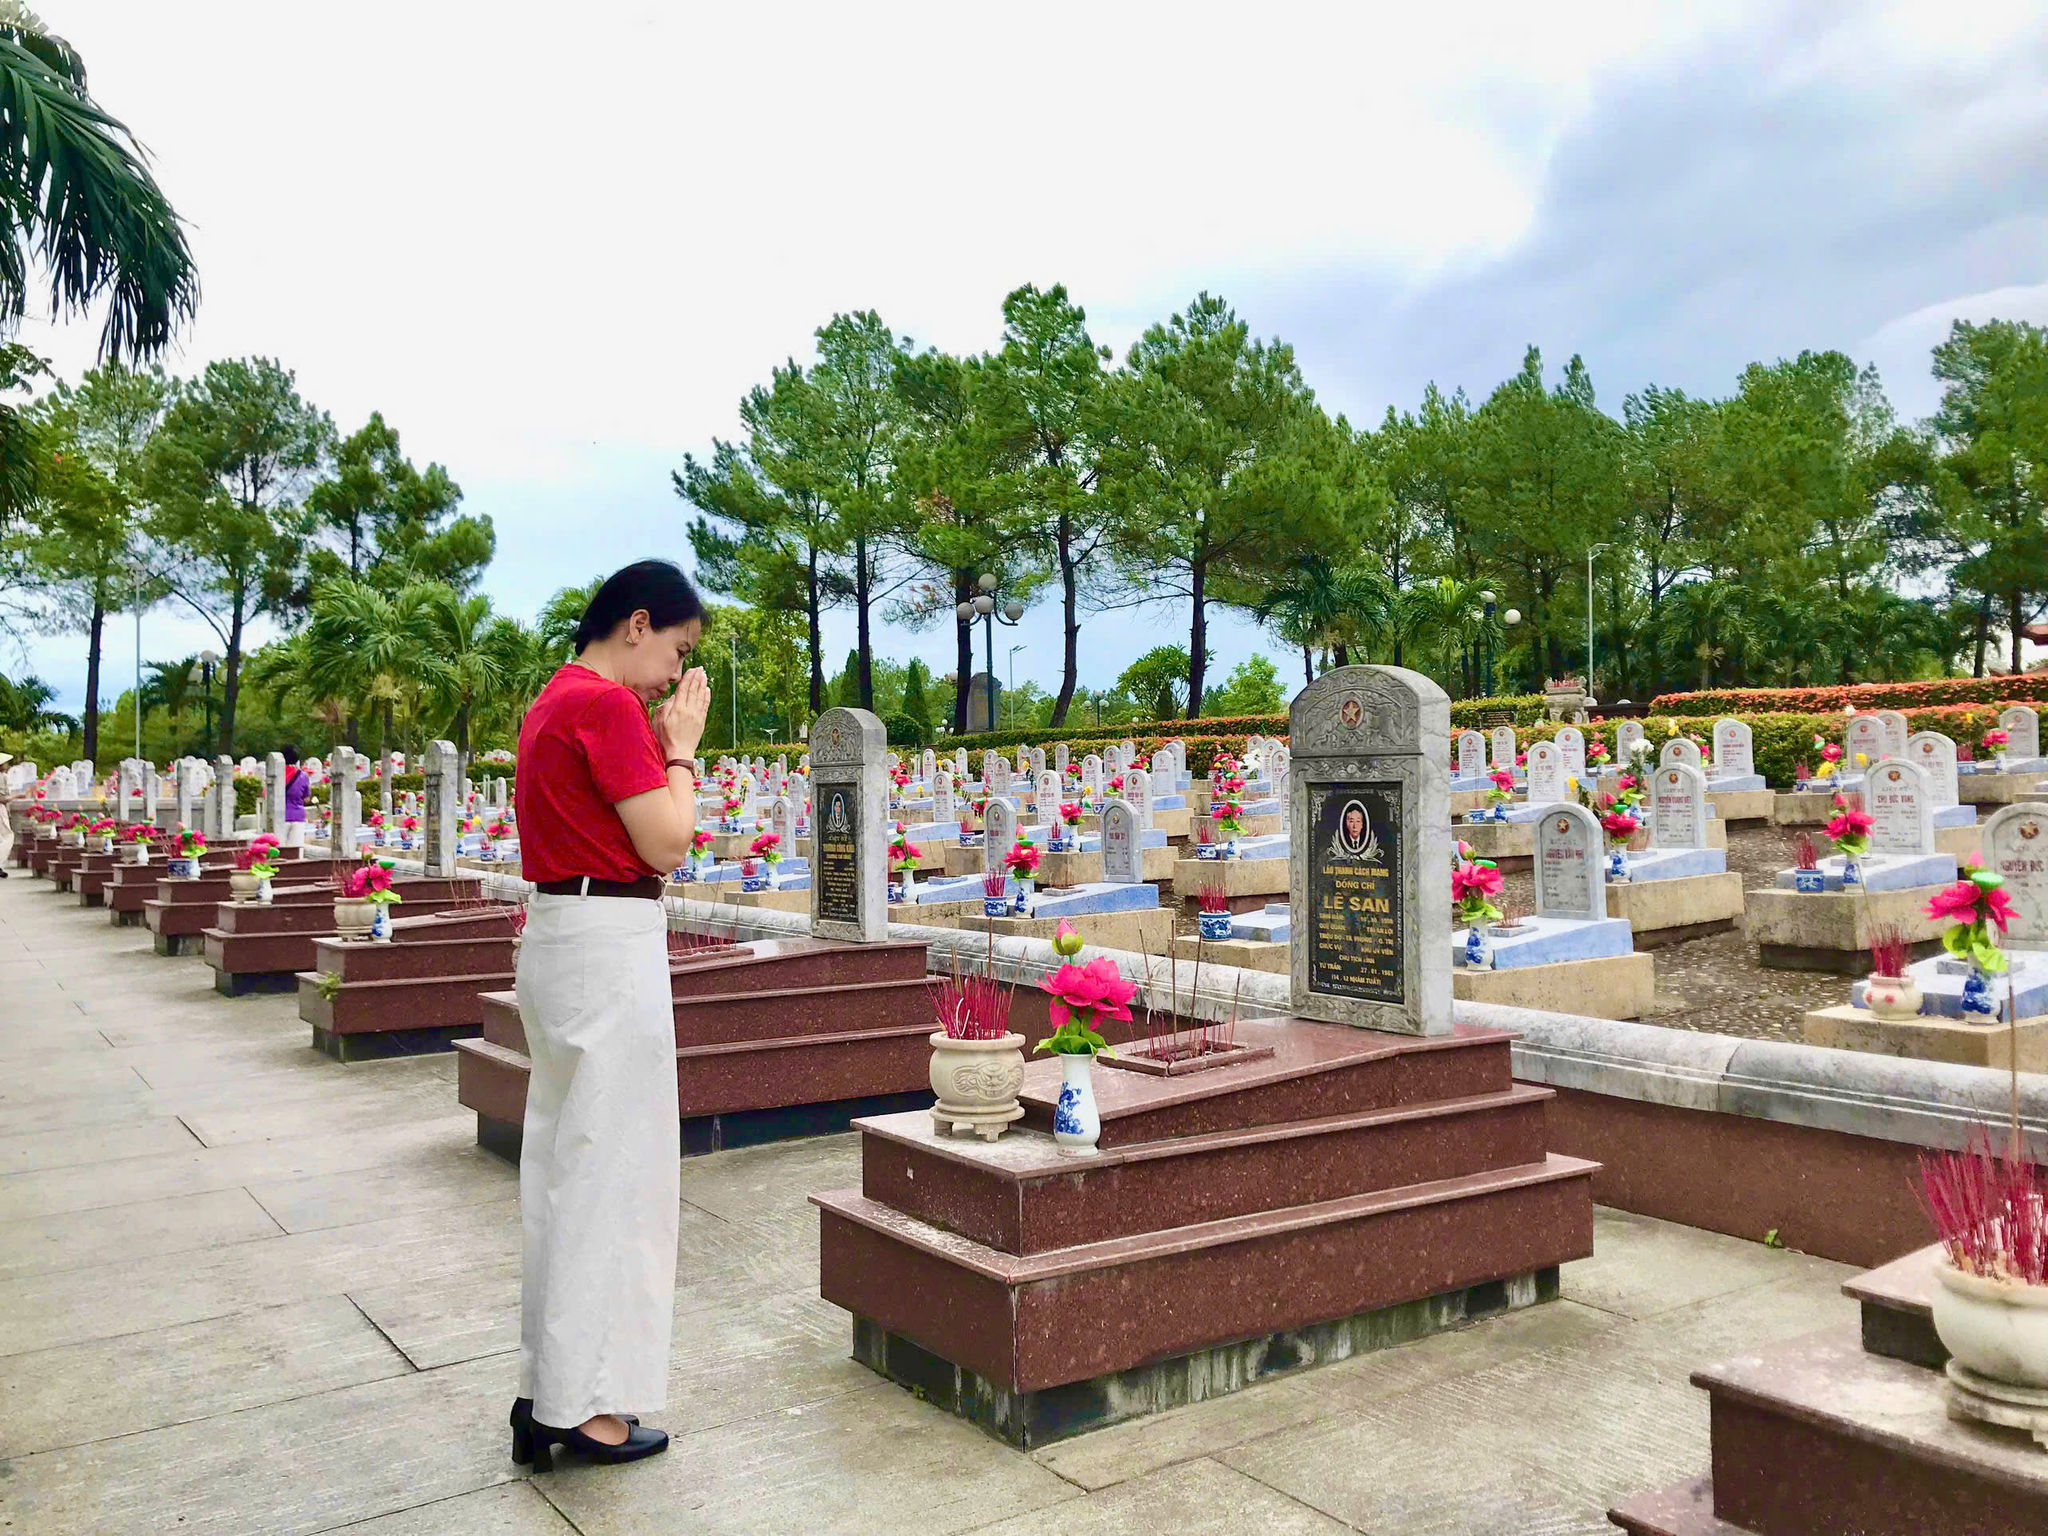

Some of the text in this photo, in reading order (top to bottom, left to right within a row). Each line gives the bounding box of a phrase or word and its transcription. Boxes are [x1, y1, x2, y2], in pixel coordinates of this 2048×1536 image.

[1361, 880, 1375, 890] CHÍ
[1323, 892, 1390, 913] LÊ SAN
